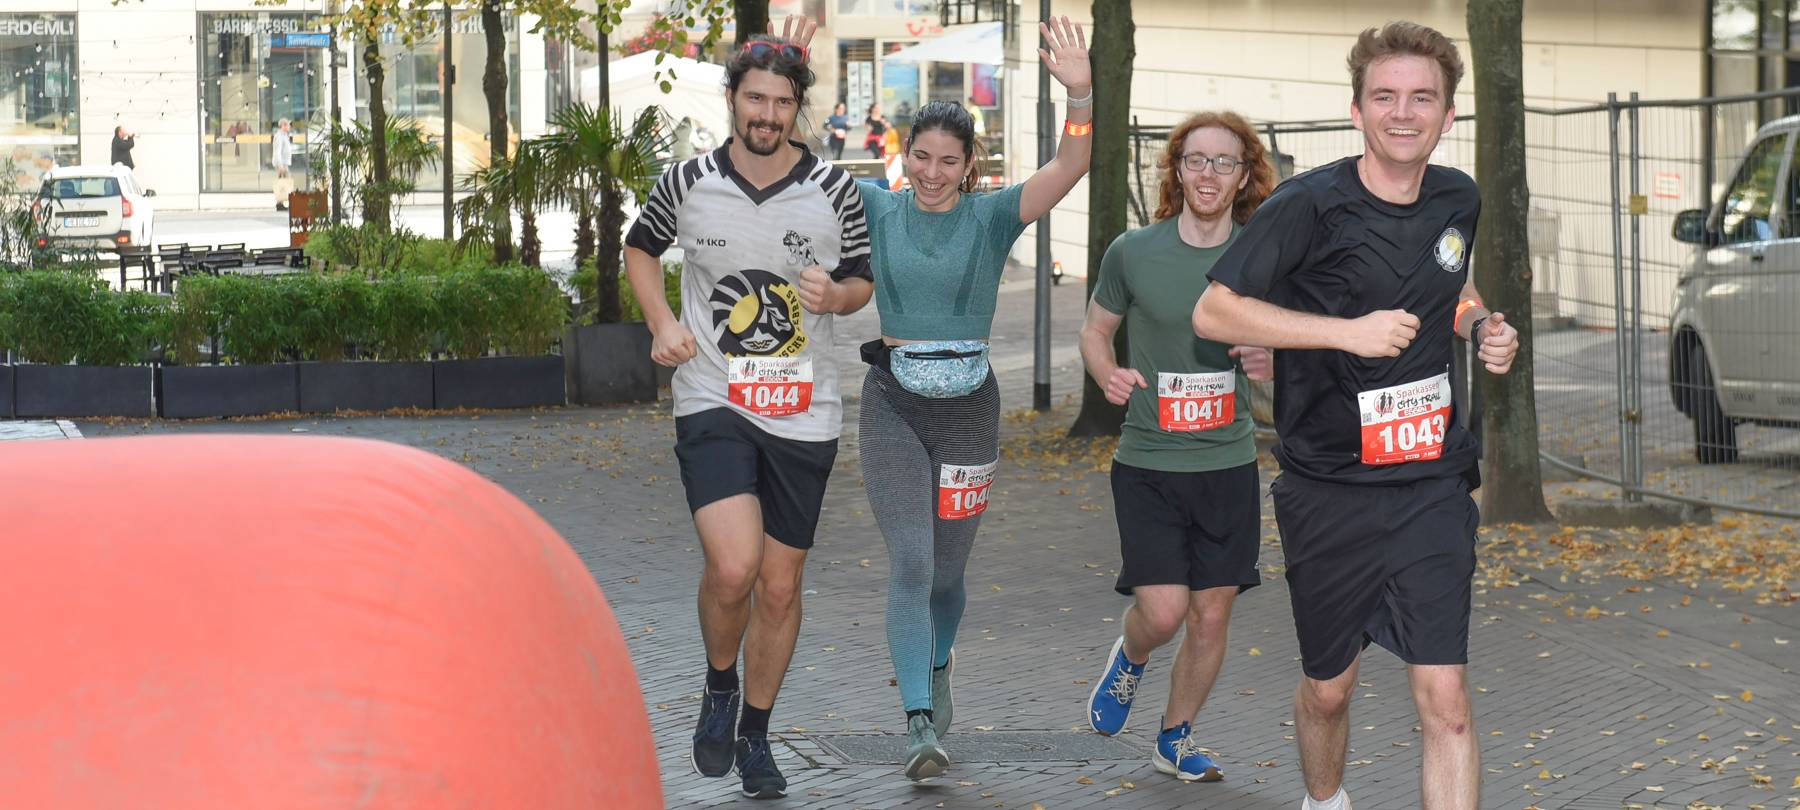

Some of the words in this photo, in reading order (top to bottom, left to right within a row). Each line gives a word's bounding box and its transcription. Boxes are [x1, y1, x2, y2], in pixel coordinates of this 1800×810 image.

[759, 360, 800, 368] Sparkassen
[1185, 375, 1226, 384] Sparkassen
[1396, 382, 1440, 399] Sparkassen
[741, 385, 799, 408] 1044
[1170, 399, 1223, 422] 1041
[1379, 414, 1446, 453] 1043
[951, 488, 988, 511] 104
